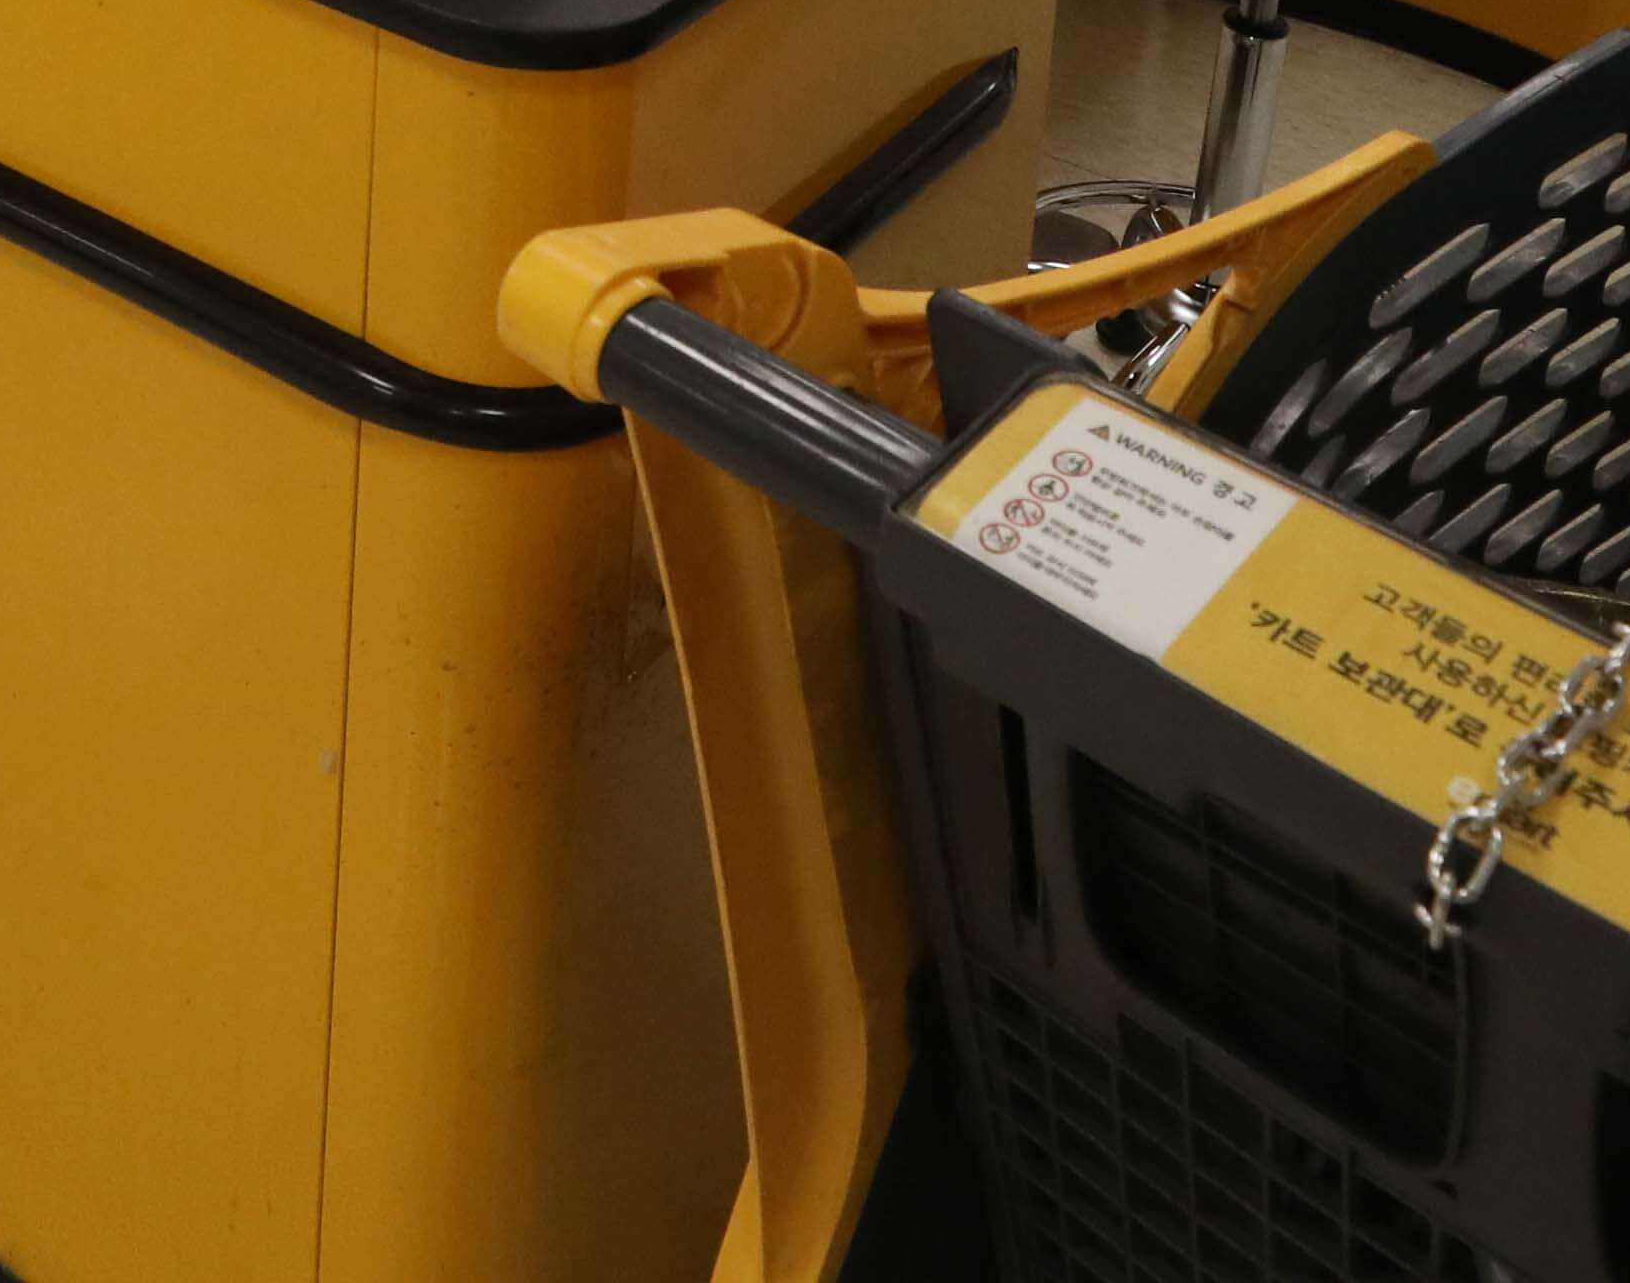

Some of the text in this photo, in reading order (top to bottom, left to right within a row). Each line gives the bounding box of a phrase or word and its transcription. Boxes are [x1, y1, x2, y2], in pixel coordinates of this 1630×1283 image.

[1115, 433, 1258, 512] WARNING 경고
[1363, 582, 1506, 665] 고객들의
[1402, 642, 1545, 729] 사용하신
